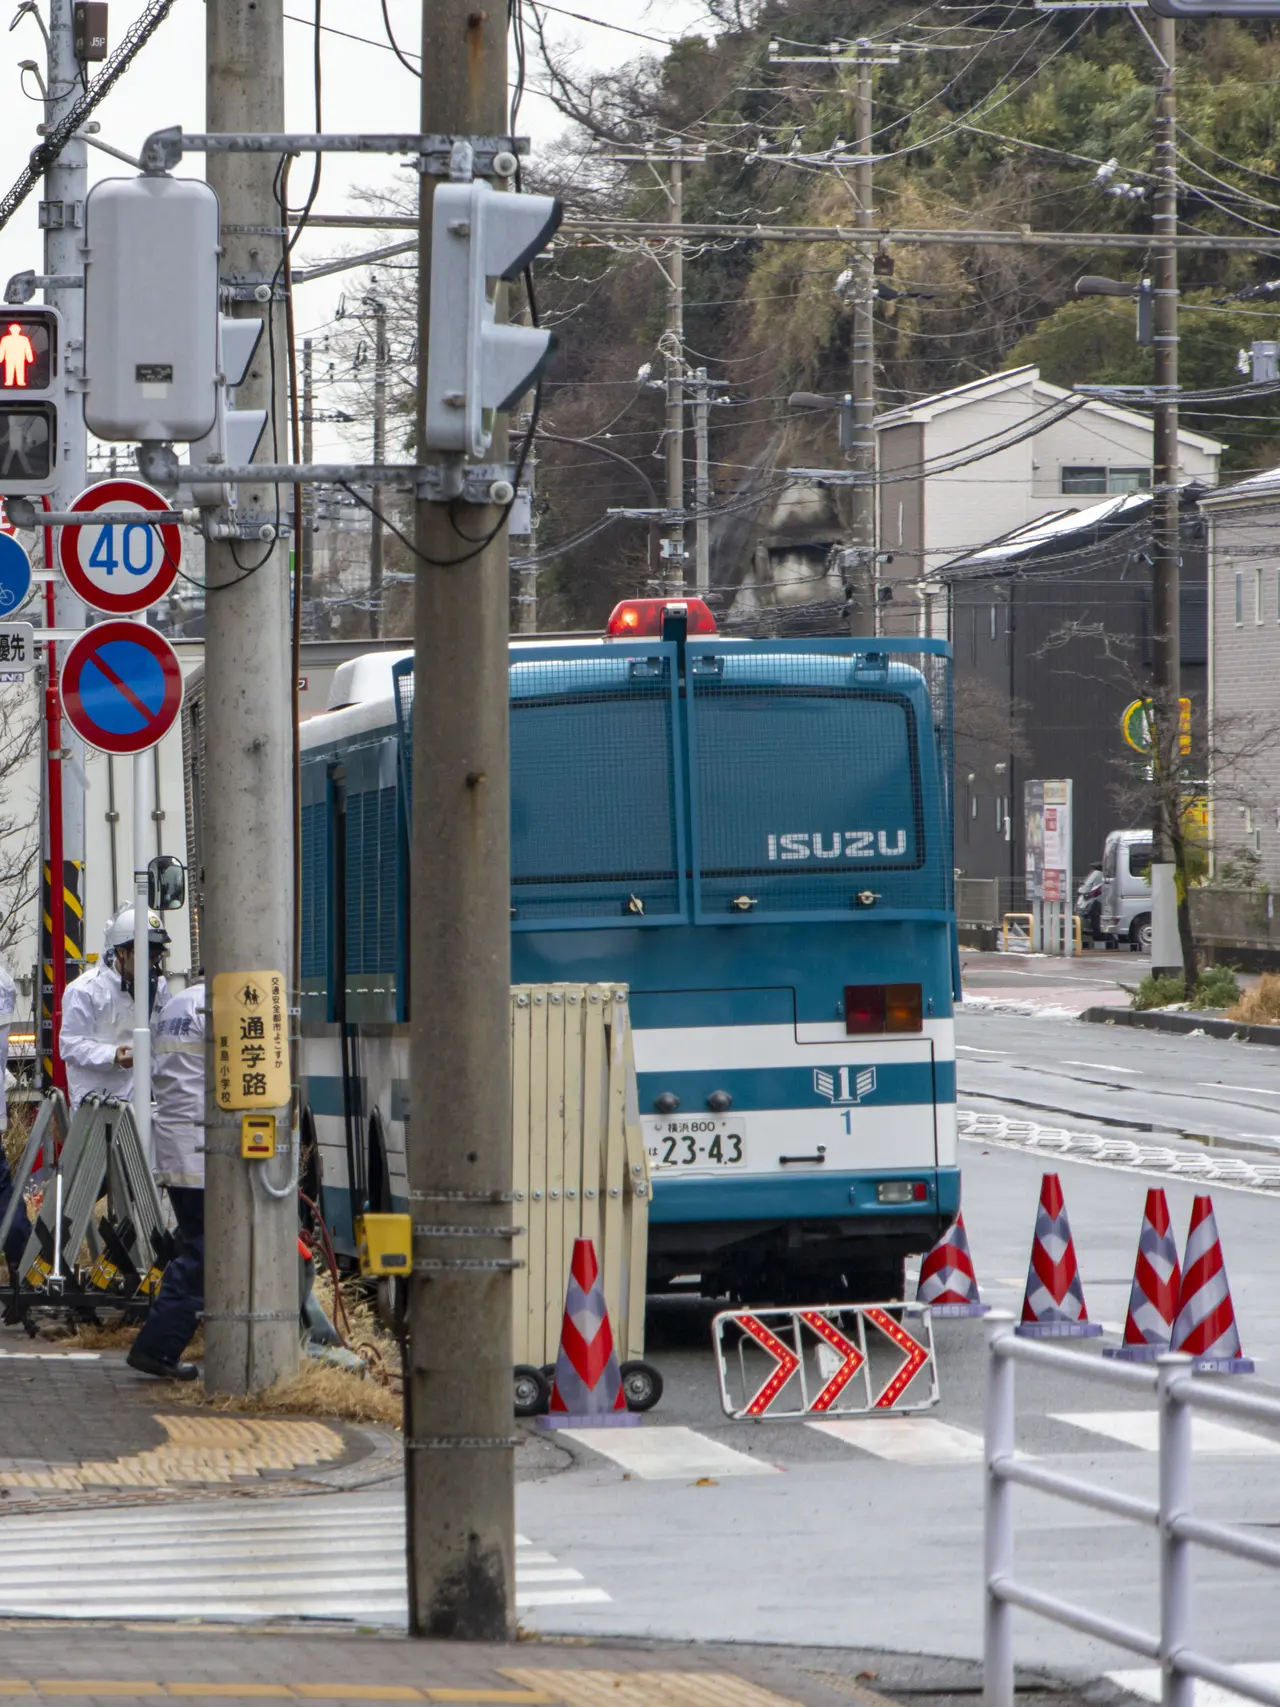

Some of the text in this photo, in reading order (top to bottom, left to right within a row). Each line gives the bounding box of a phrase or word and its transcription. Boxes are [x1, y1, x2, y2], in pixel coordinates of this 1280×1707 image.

[88, 523, 153, 576] 40
[768, 830, 907, 860] ISUZU
[240, 1016, 267, 1097] 通学路
[840, 1109, 851, 1135] 1
